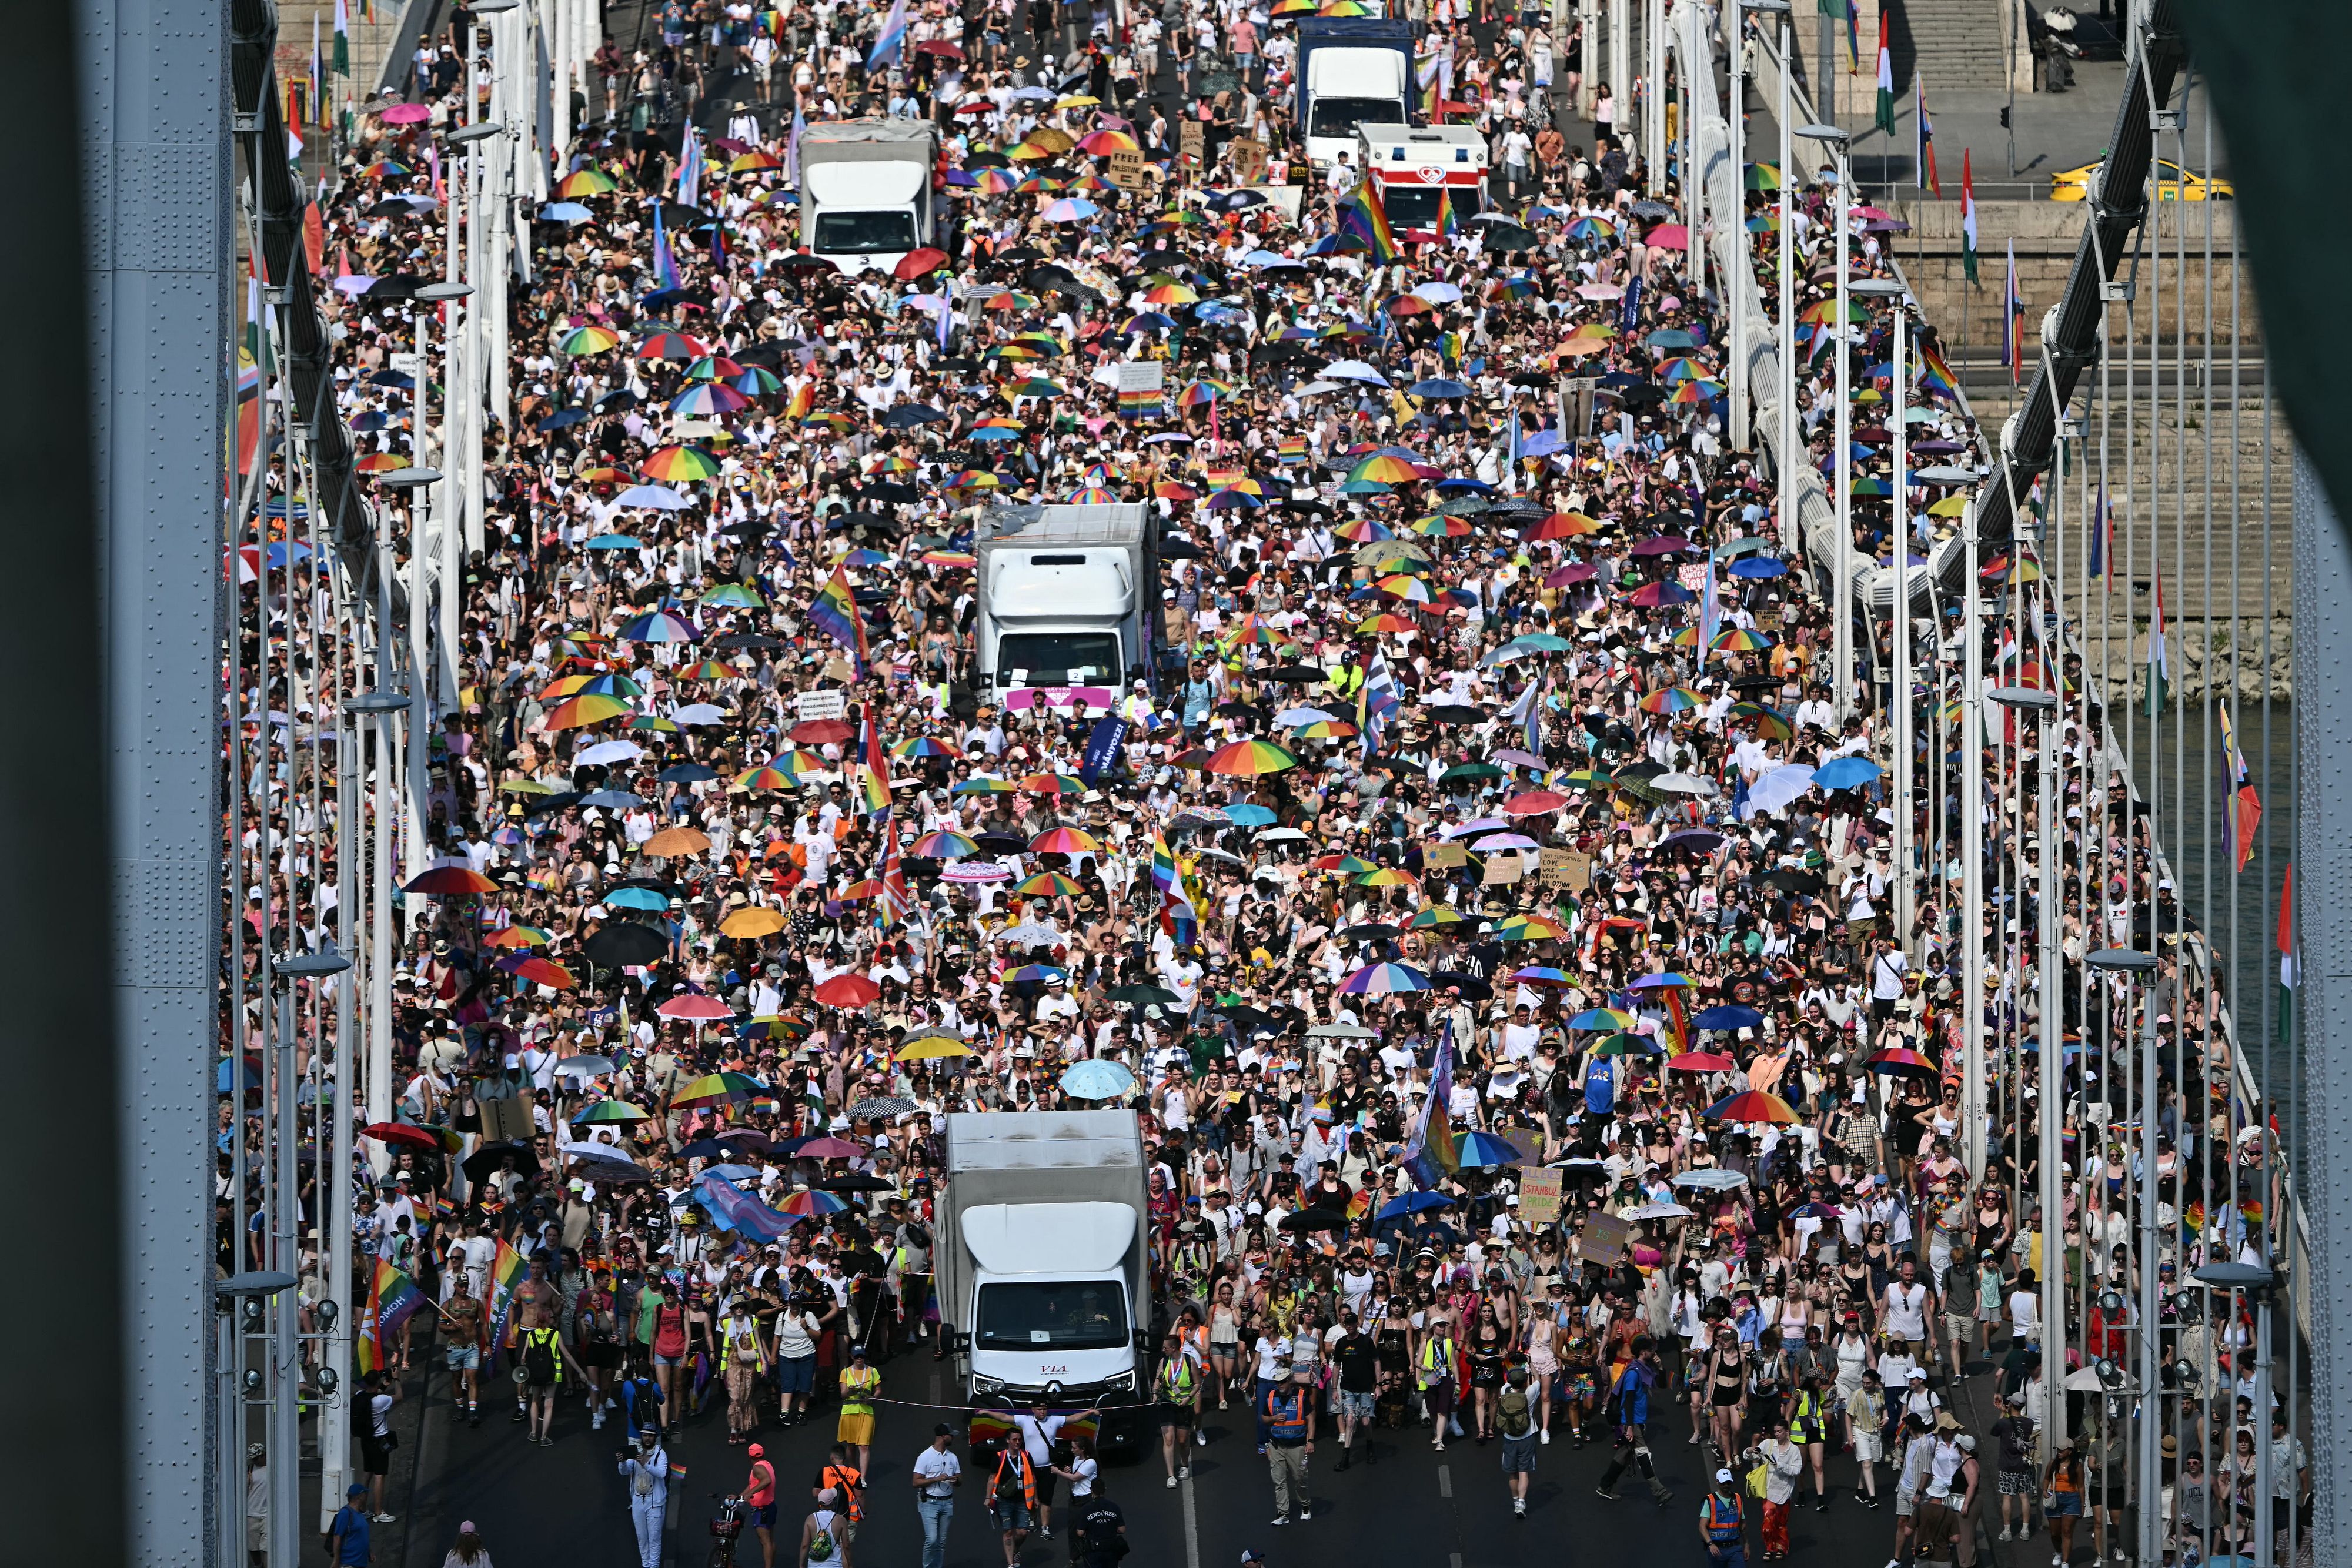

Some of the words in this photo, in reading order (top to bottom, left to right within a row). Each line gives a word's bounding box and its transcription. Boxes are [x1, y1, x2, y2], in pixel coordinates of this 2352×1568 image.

[1114, 153, 1140, 163] FREE
[1111, 164, 1141, 174] PALESTINE
[860, 256, 870, 265] 3
[1522, 1169, 1539, 1179] ALL
[1541, 1170, 1561, 1181] EYES
[1522, 1183, 1559, 1197] İSTANBUL
[1526, 1196, 1555, 1208] PRIDE
[1040, 1365, 1068, 1373] VIA
[828, 1472, 854, 1480] RENZŐ
[2188, 1487, 2204, 1499] UCL
